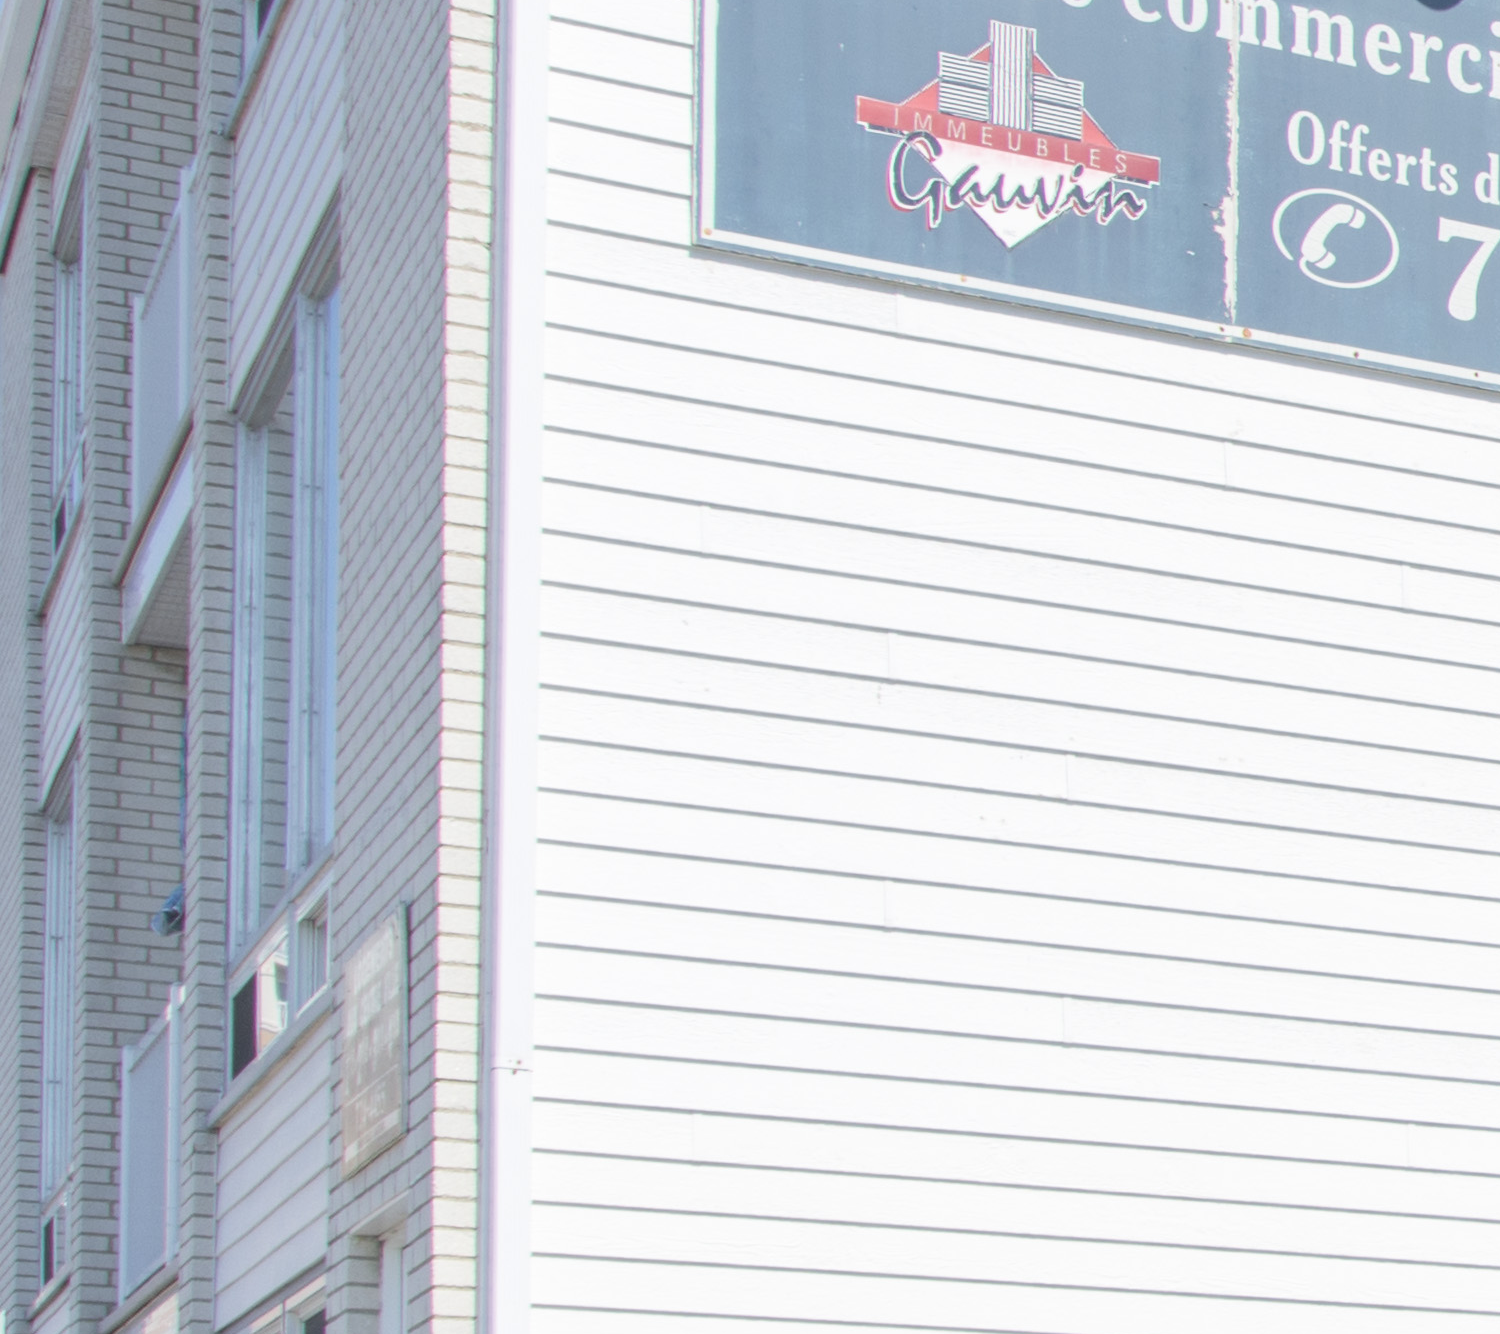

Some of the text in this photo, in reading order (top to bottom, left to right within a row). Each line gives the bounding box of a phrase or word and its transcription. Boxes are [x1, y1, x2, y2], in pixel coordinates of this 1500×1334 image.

[887, 130, 1147, 231] Gauvin
[893, 107, 1128, 174] IMMEUBLES
[1286, 109, 1458, 197] Offerts
